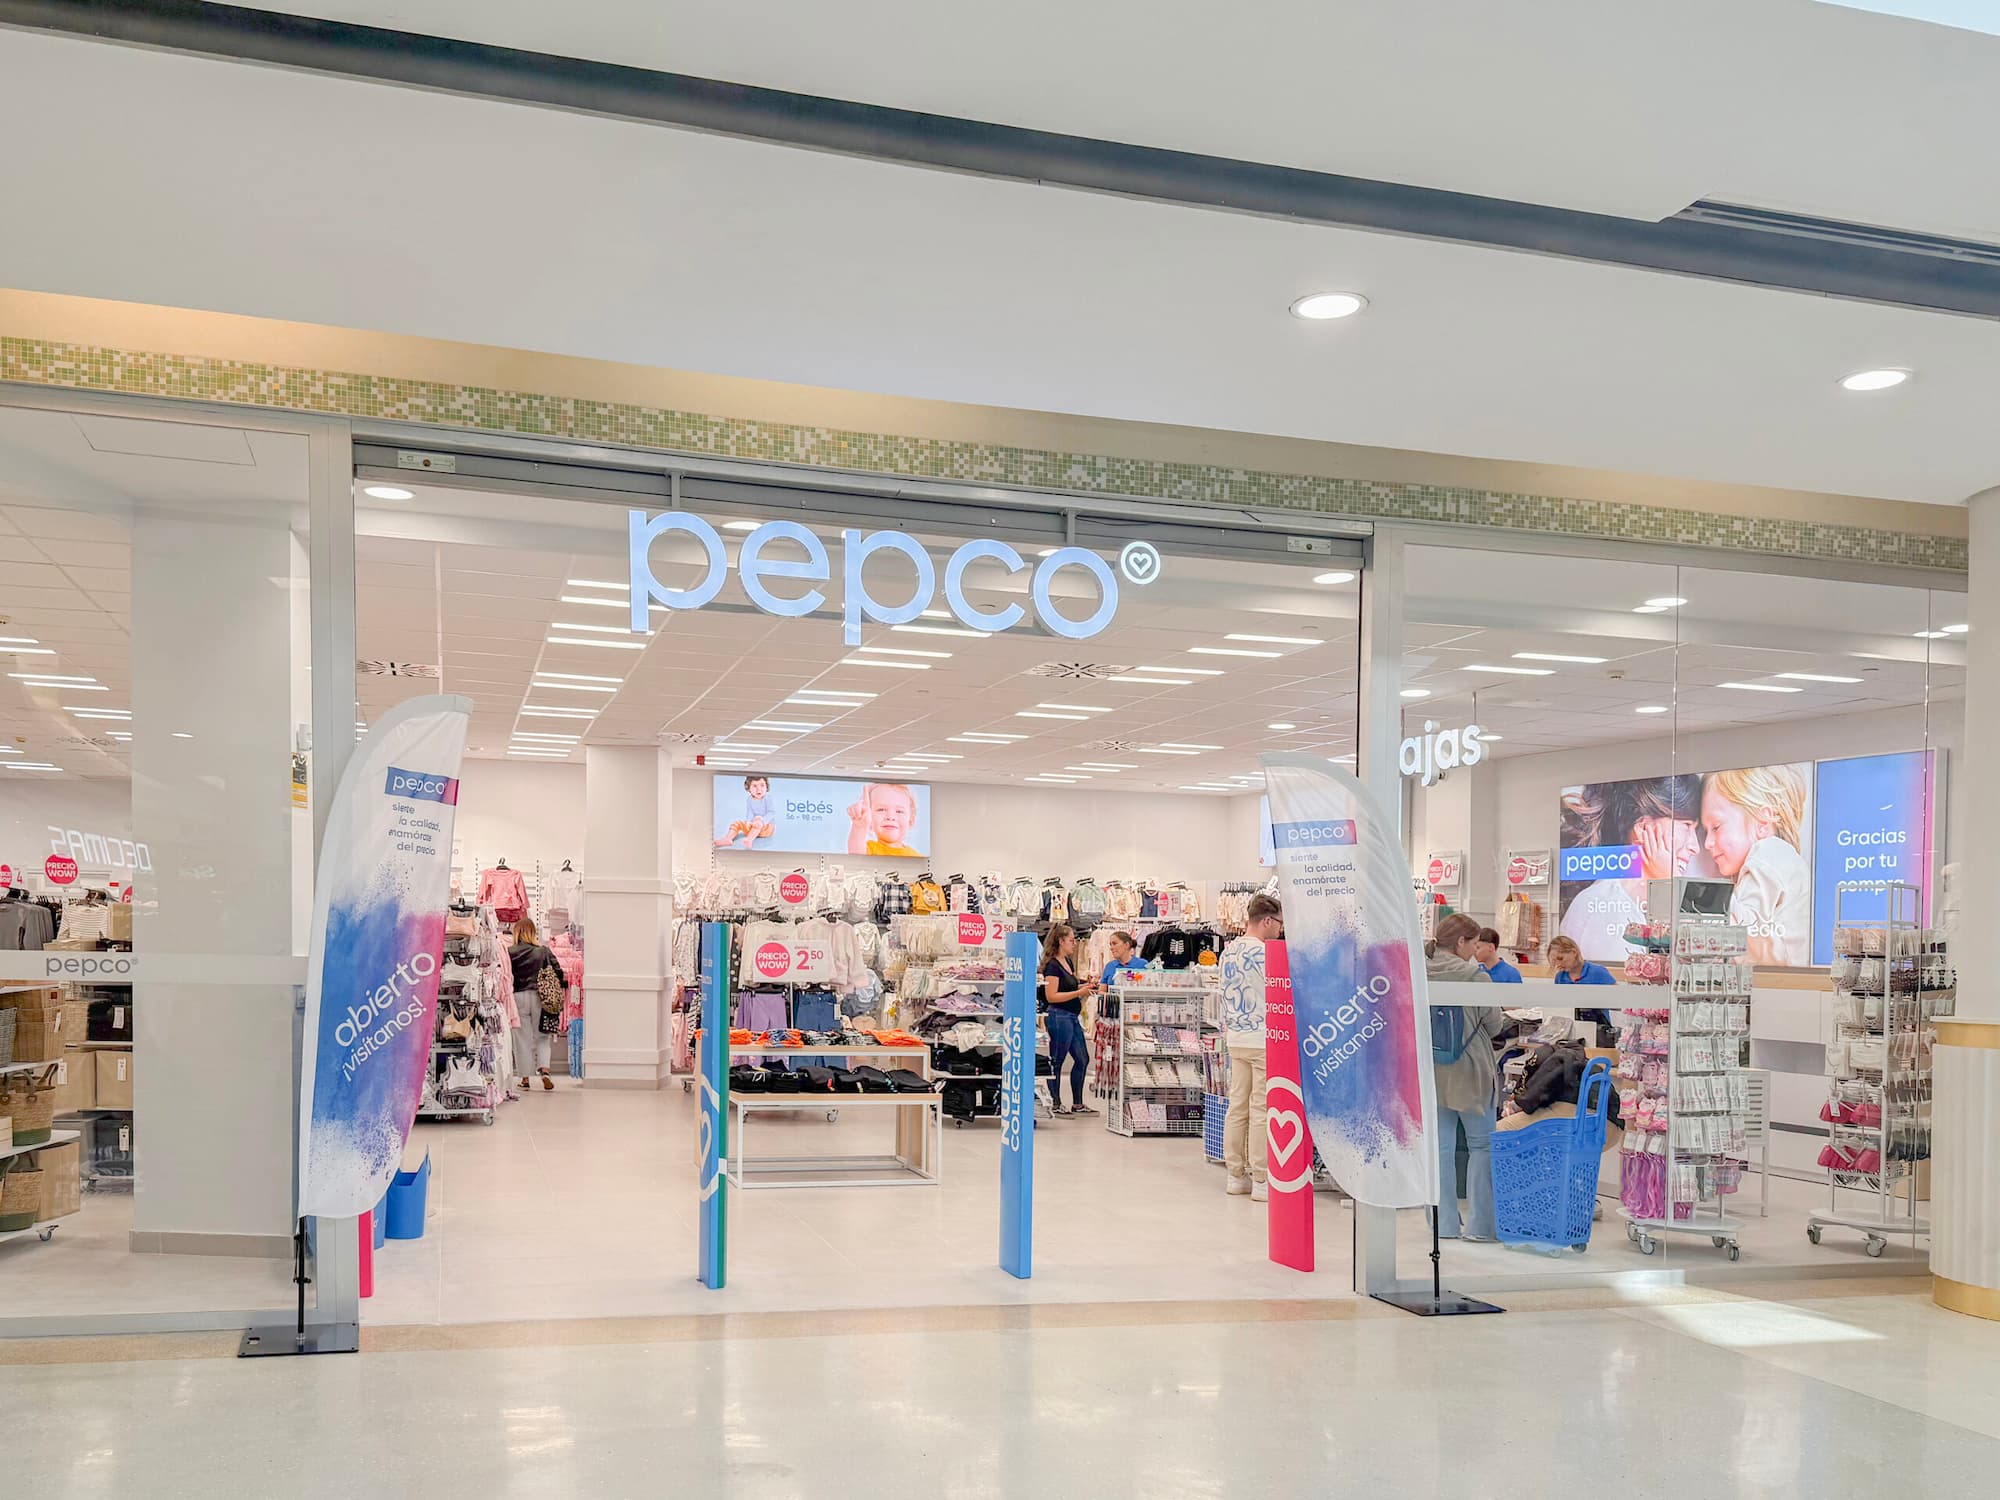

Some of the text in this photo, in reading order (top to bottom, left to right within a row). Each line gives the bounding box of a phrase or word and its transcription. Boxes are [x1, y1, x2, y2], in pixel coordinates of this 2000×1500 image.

[629, 510, 1119, 647] pepco
[1400, 720, 1485, 787] ajas
[786, 799, 833, 814] bebés
[398, 815, 407, 826] la
[1287, 826, 1345, 843] pepco
[1836, 827, 1907, 846] Gracias
[396, 841, 414, 851] del
[1290, 853, 1319, 862] siente
[1566, 852, 1632, 876] pepco
[1844, 853, 1897, 873] por tu
[46, 862, 77, 871] PRECIO
[1304, 862, 1356, 873] la calidad,
[47, 870, 77, 878] WOW!
[1292, 875, 1347, 886] enamórate
[782, 882, 807, 890] PRECIO
[782, 889, 807, 897] WOW!
[1306, 886, 1356, 897] del precio
[1587, 897, 1632, 913] siente
[959, 921, 985, 929] PRECIO
[1747, 923, 1786, 937] ecio
[960, 928, 985, 937] WOW!
[757, 952, 789, 960] PRECIO
[796, 950, 824, 970] 2 50
[46, 957, 131, 977] pepco
[758, 960, 789, 969] WOW!
[1005, 956, 1023, 972] UEVA
[334, 952, 436, 1047] abierto
[1265, 1000, 1294, 1015] precio
[1302, 975, 1391, 1057] abierto
[1001, 1016, 1013, 1146] NUEVA
